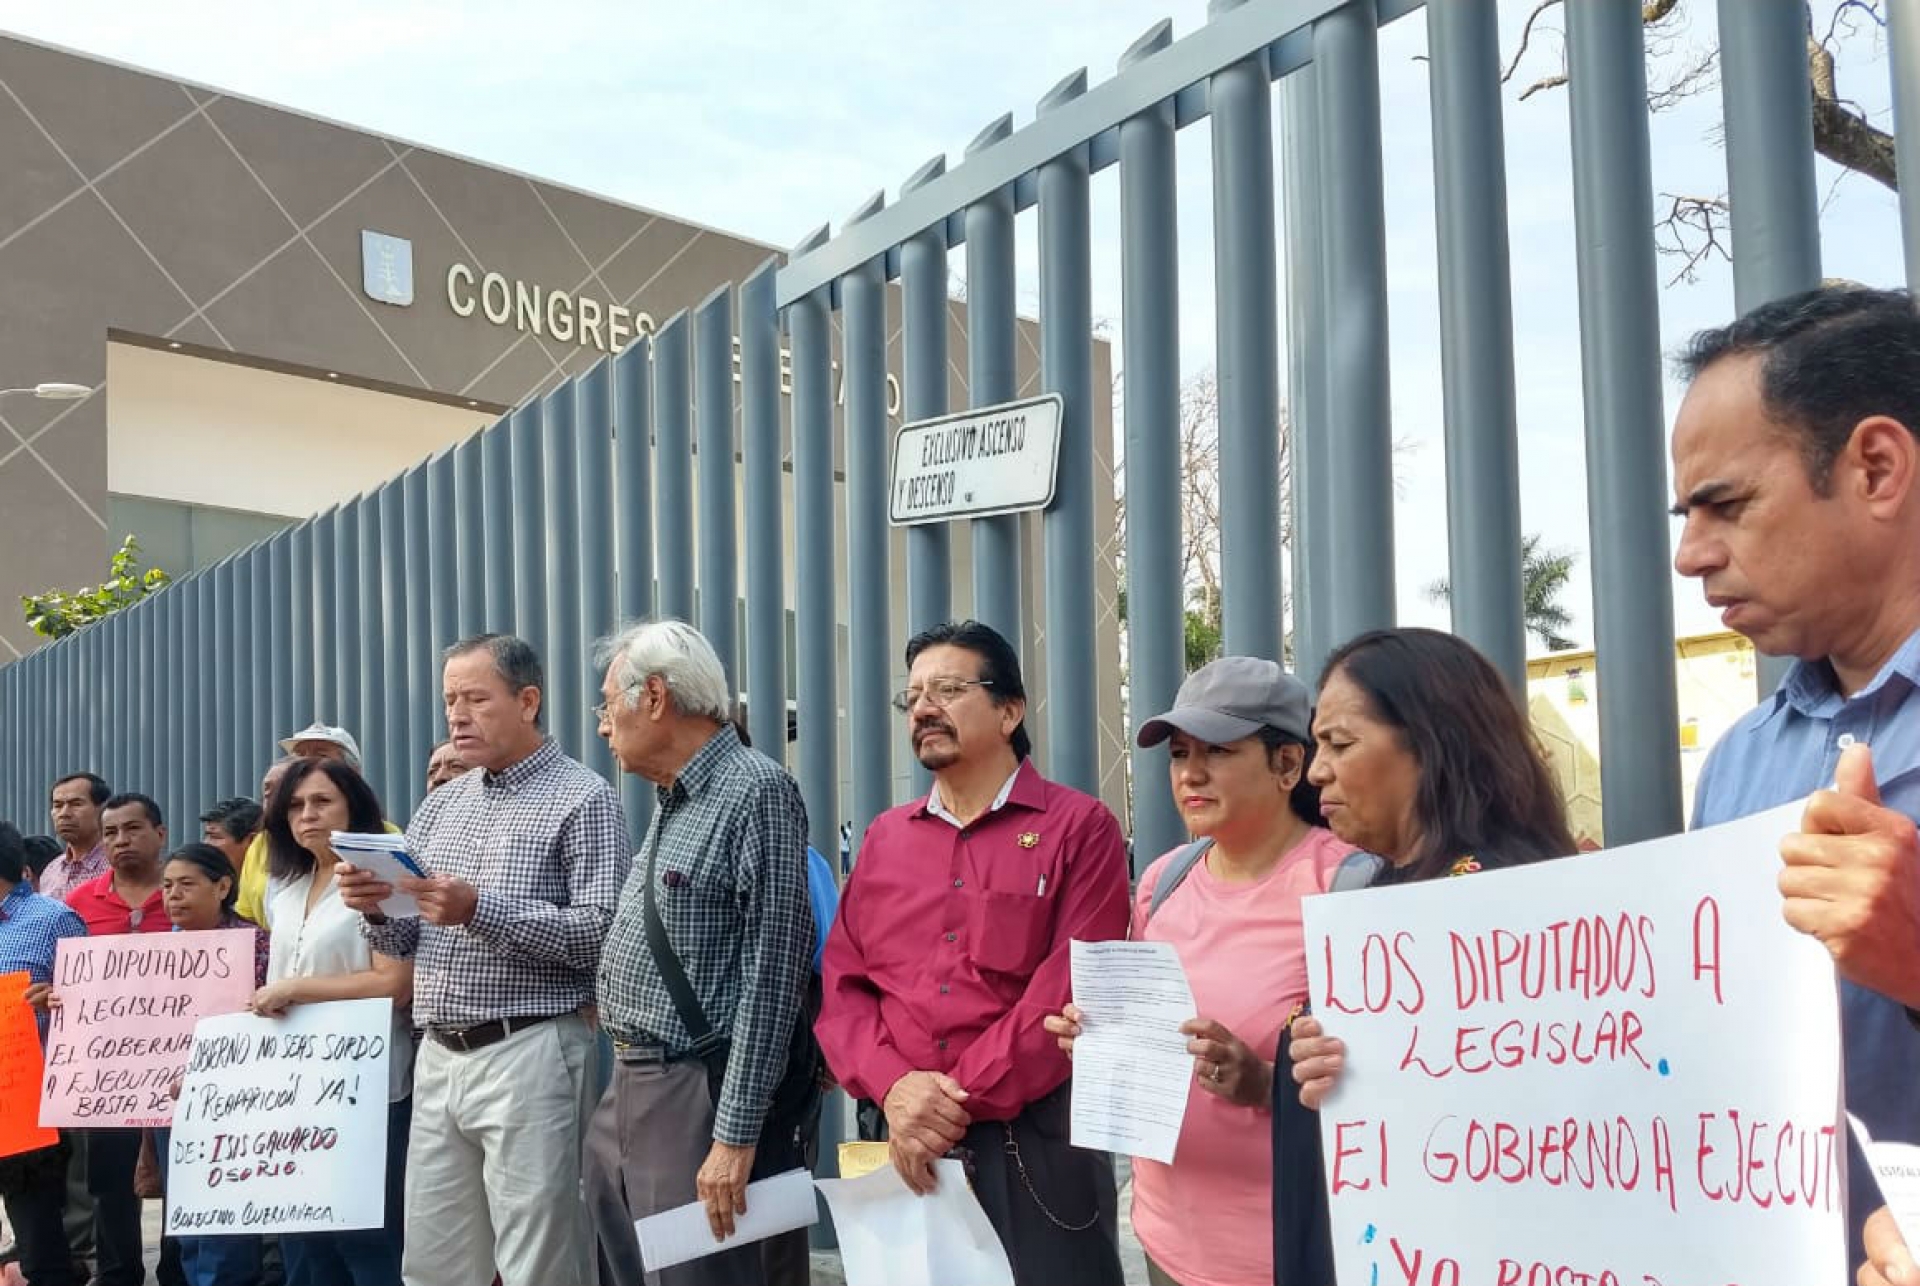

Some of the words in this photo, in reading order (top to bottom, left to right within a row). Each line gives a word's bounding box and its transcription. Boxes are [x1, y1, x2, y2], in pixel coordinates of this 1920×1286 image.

[922, 425, 976, 467] EXCLUSIVO
[977, 416, 1025, 459] ASCENSO
[907, 470, 956, 510] DESCENSO
[61, 949, 94, 987] LOS
[103, 947, 231, 981] DIPUTADOS
[1325, 931, 1424, 1014] LOS
[1450, 911, 1656, 1011] DIPUTADOS
[1693, 895, 1724, 1005] A
[87, 1032, 194, 1060] GOBERNA
[256, 1035, 277, 1062] NO
[320, 1034, 385, 1060] SORDO
[72, 1093, 138, 1118] BASTA
[1423, 1115, 1641, 1190] GOBIERNO
[1653, 1115, 1679, 1214] A
[1697, 1109, 1843, 1213] EJECUT
